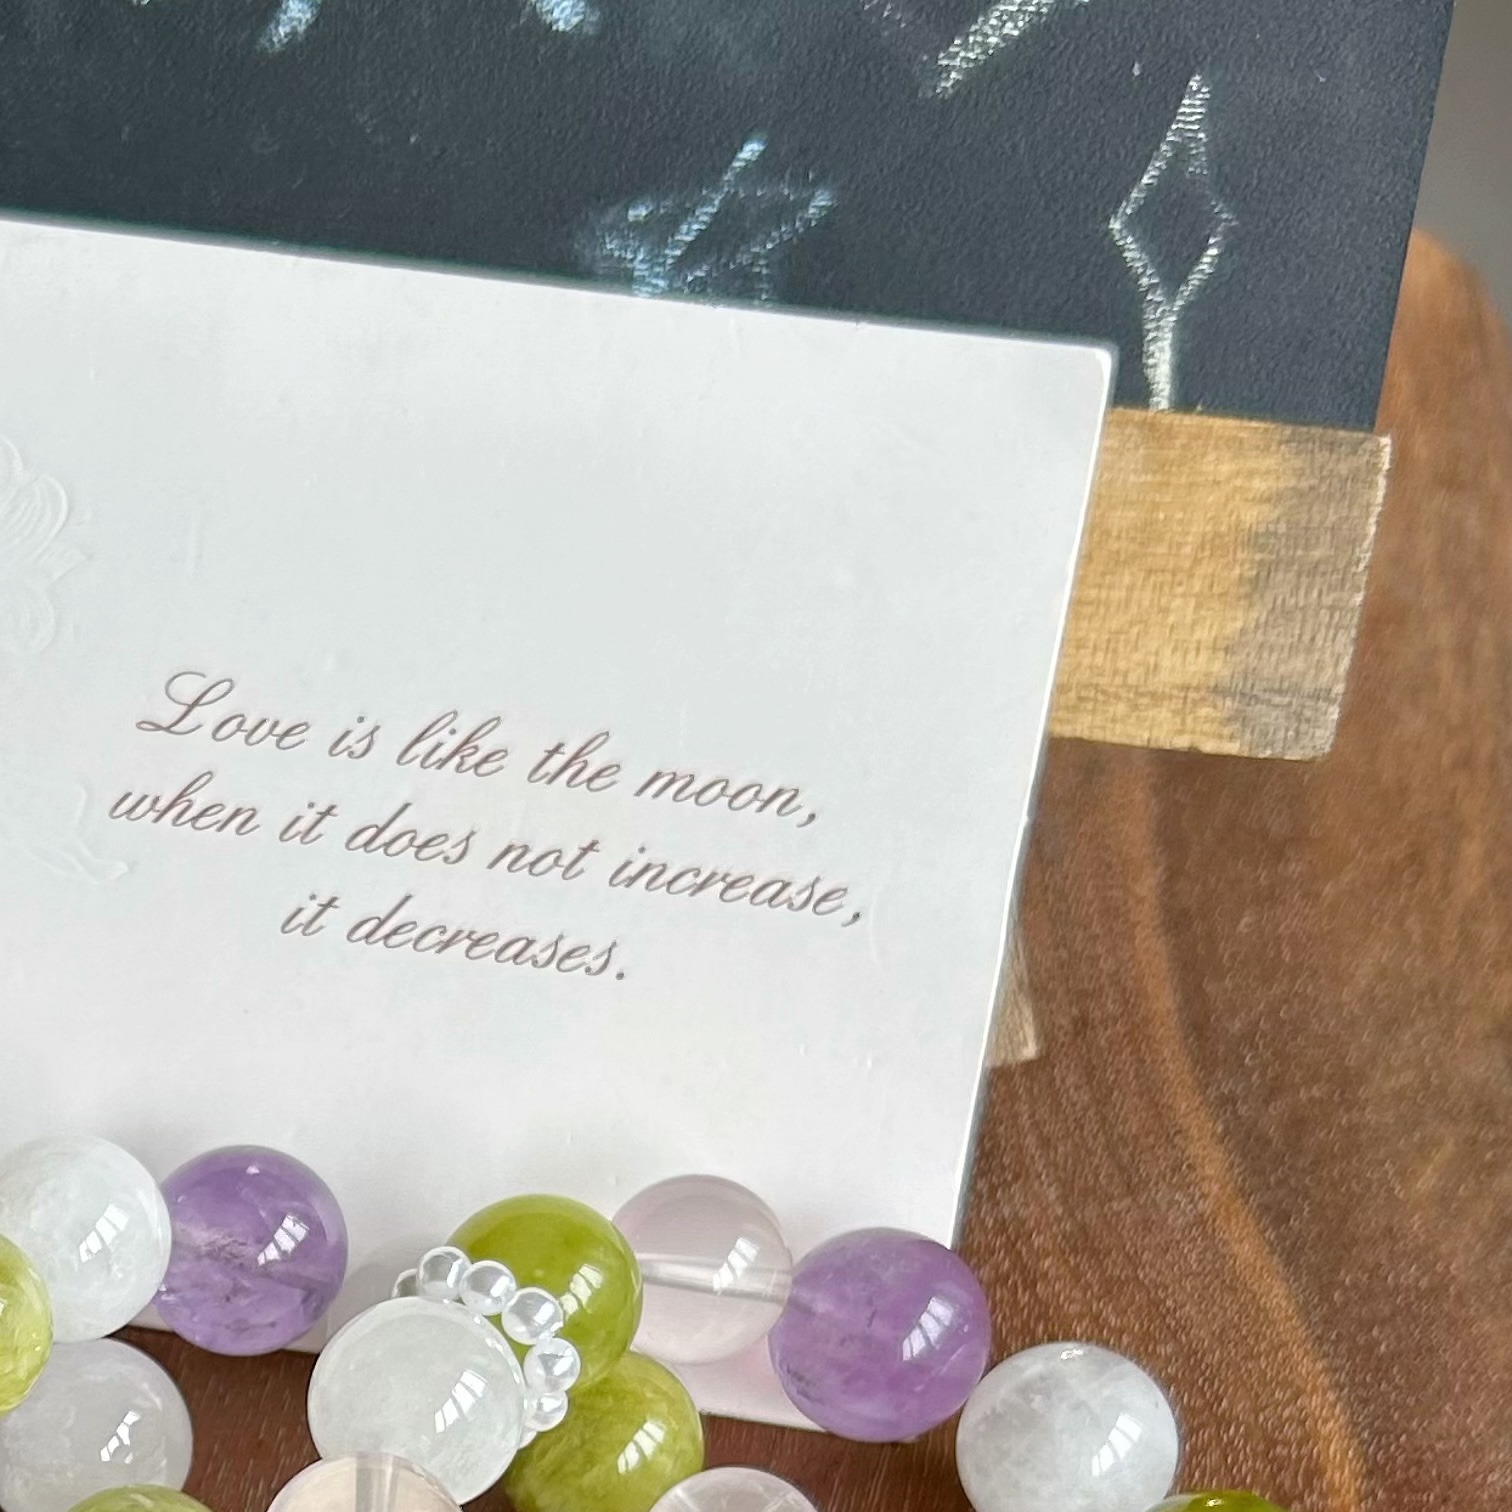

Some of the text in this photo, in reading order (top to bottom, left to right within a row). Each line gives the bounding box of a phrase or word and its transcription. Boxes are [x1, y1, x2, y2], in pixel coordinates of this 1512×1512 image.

[135, 671, 816, 828] Love is like the moon,
[109, 770, 863, 927] when it does not increase,
[280, 893, 625, 981] it decreases.
